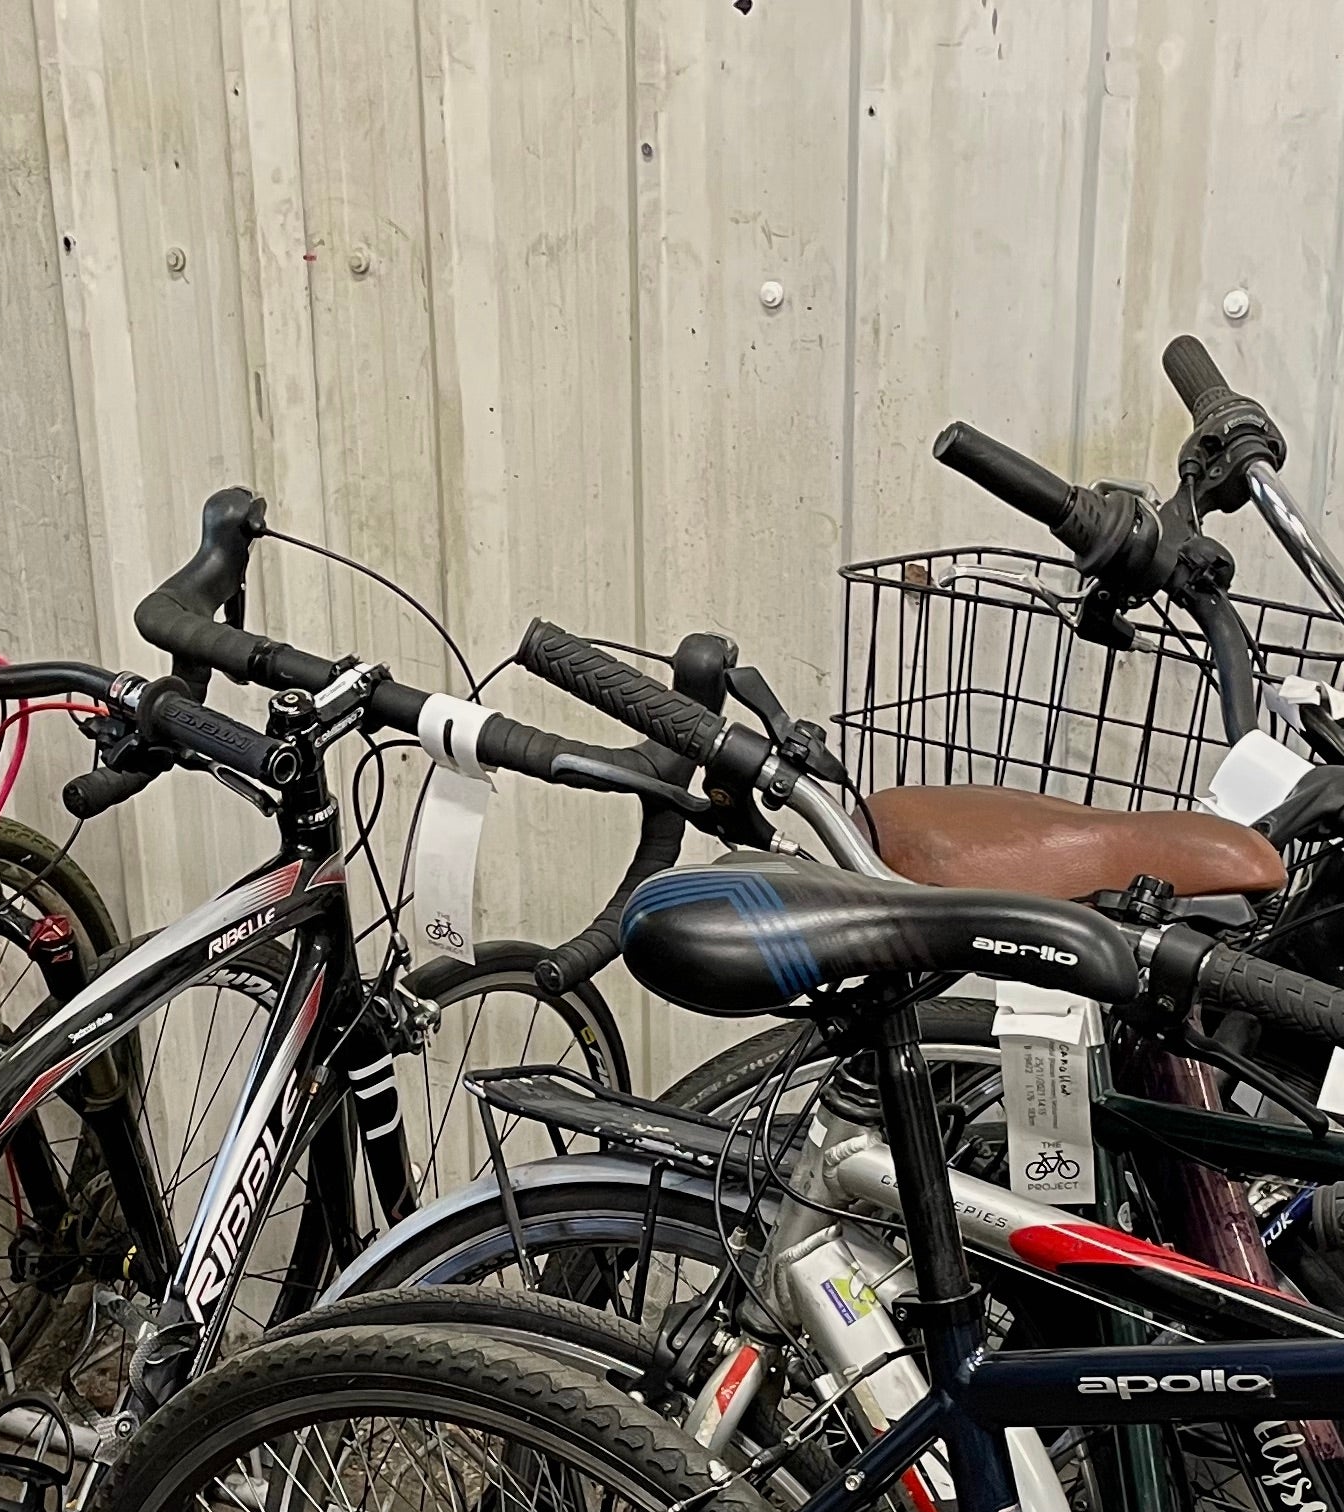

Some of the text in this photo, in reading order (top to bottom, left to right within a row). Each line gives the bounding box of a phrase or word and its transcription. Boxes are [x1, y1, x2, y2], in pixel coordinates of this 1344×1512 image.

[207, 906, 276, 960] RIBELLE
[1040, 1140, 1062, 1149] THE
[183, 1072, 304, 1325] RIBBLE
[1027, 1181, 1080, 1191] PROJECT
[1076, 1368, 1275, 1401] apollo
